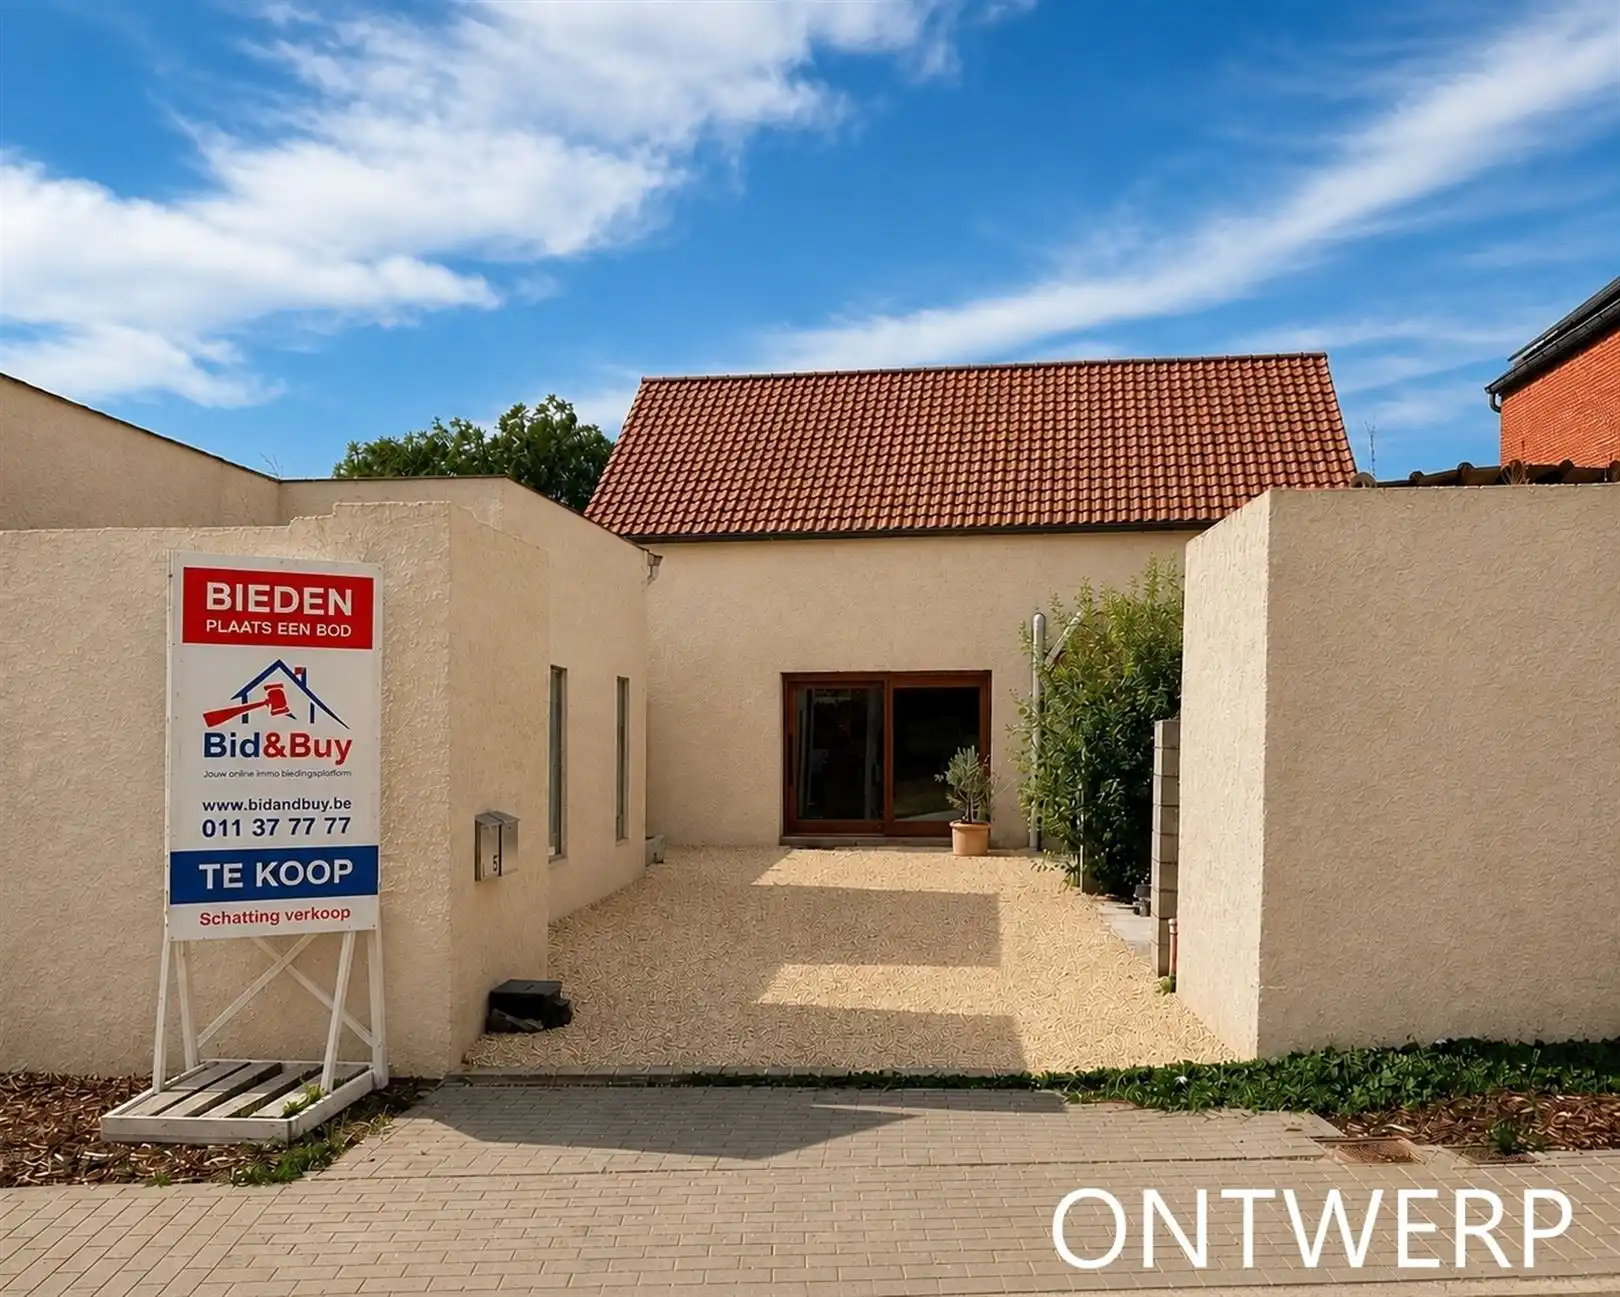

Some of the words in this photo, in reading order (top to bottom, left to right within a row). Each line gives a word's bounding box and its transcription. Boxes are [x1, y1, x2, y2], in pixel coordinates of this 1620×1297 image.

[206, 581, 352, 616] BIEDEN
[206, 619, 272, 635] PLAATS
[277, 622, 311, 636] EEN
[316, 624, 351, 637] BOD
[204, 732, 353, 765] Bid&Buy
[203, 770, 227, 778] Jouw
[228, 769, 254, 778] online
[203, 797, 352, 813] www.bidandbuy.be
[202, 819, 242, 837] 011
[252, 818, 280, 836] 37
[288, 817, 316, 835] 77
[324, 816, 351, 834] 77
[199, 862, 244, 889] TE
[255, 859, 353, 888] KOOP
[200, 910, 280, 926] Schatting
[285, 906, 351, 921] verkoop
